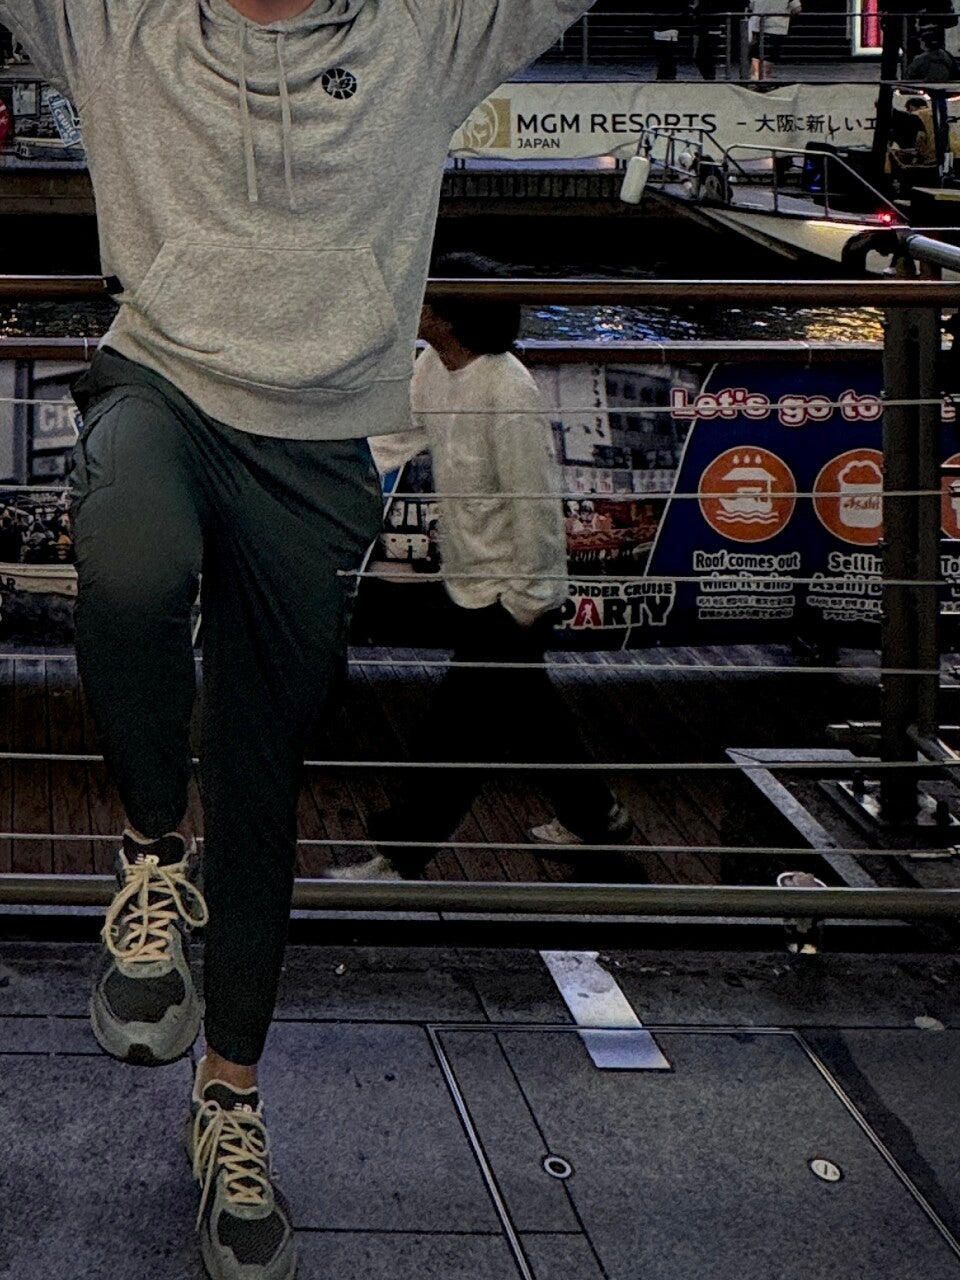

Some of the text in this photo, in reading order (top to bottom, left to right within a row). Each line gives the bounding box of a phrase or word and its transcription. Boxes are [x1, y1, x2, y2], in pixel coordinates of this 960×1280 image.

[516, 113, 717, 134] MGM RESORTS
[517, 137, 560, 150] JAPAN
[670, 388, 884, 428] Let's go to
[694, 552, 801, 570] Roof comes out
[829, 554, 883, 573] Sellin
[567, 581, 673, 599] ONDER CRUISE
